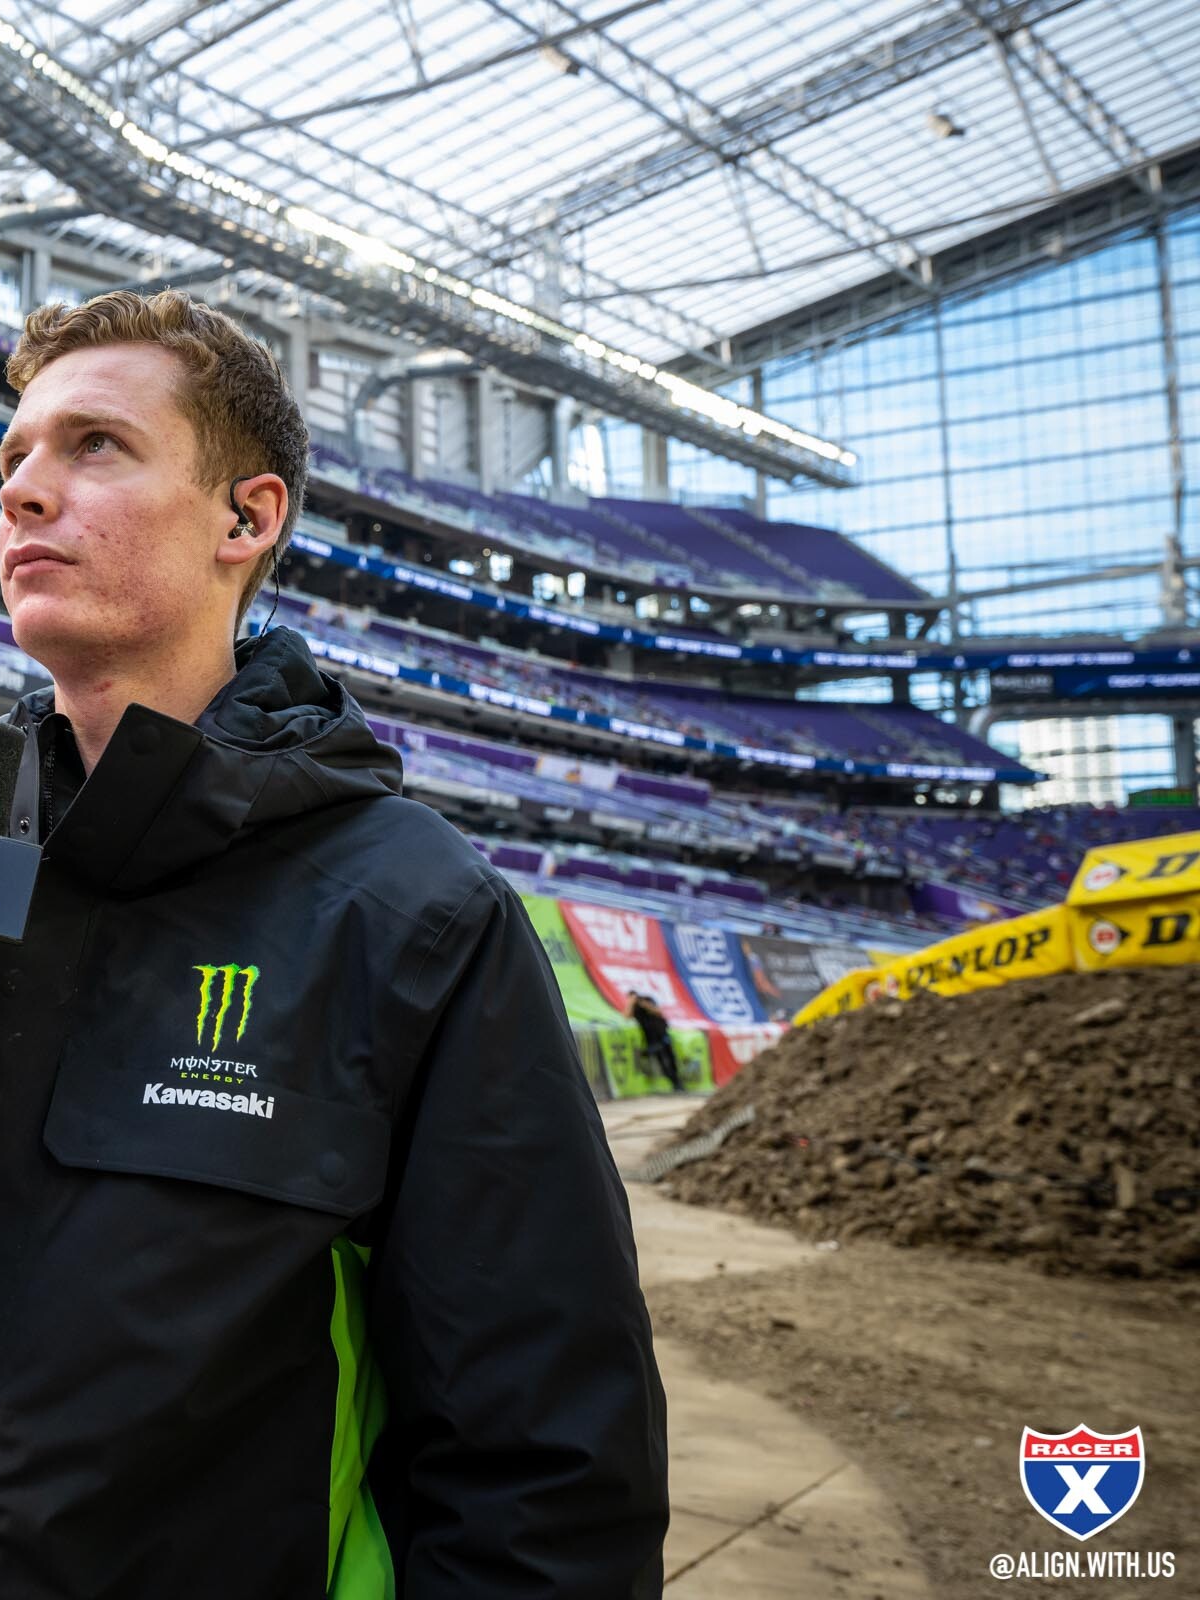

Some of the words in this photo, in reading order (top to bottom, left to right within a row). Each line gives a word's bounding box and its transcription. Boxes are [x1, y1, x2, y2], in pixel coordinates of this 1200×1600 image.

[905, 928, 1051, 990] DUNLOP
[180, 1072, 244, 1084] ENERGY
[142, 1082, 275, 1119] Kawasaki
